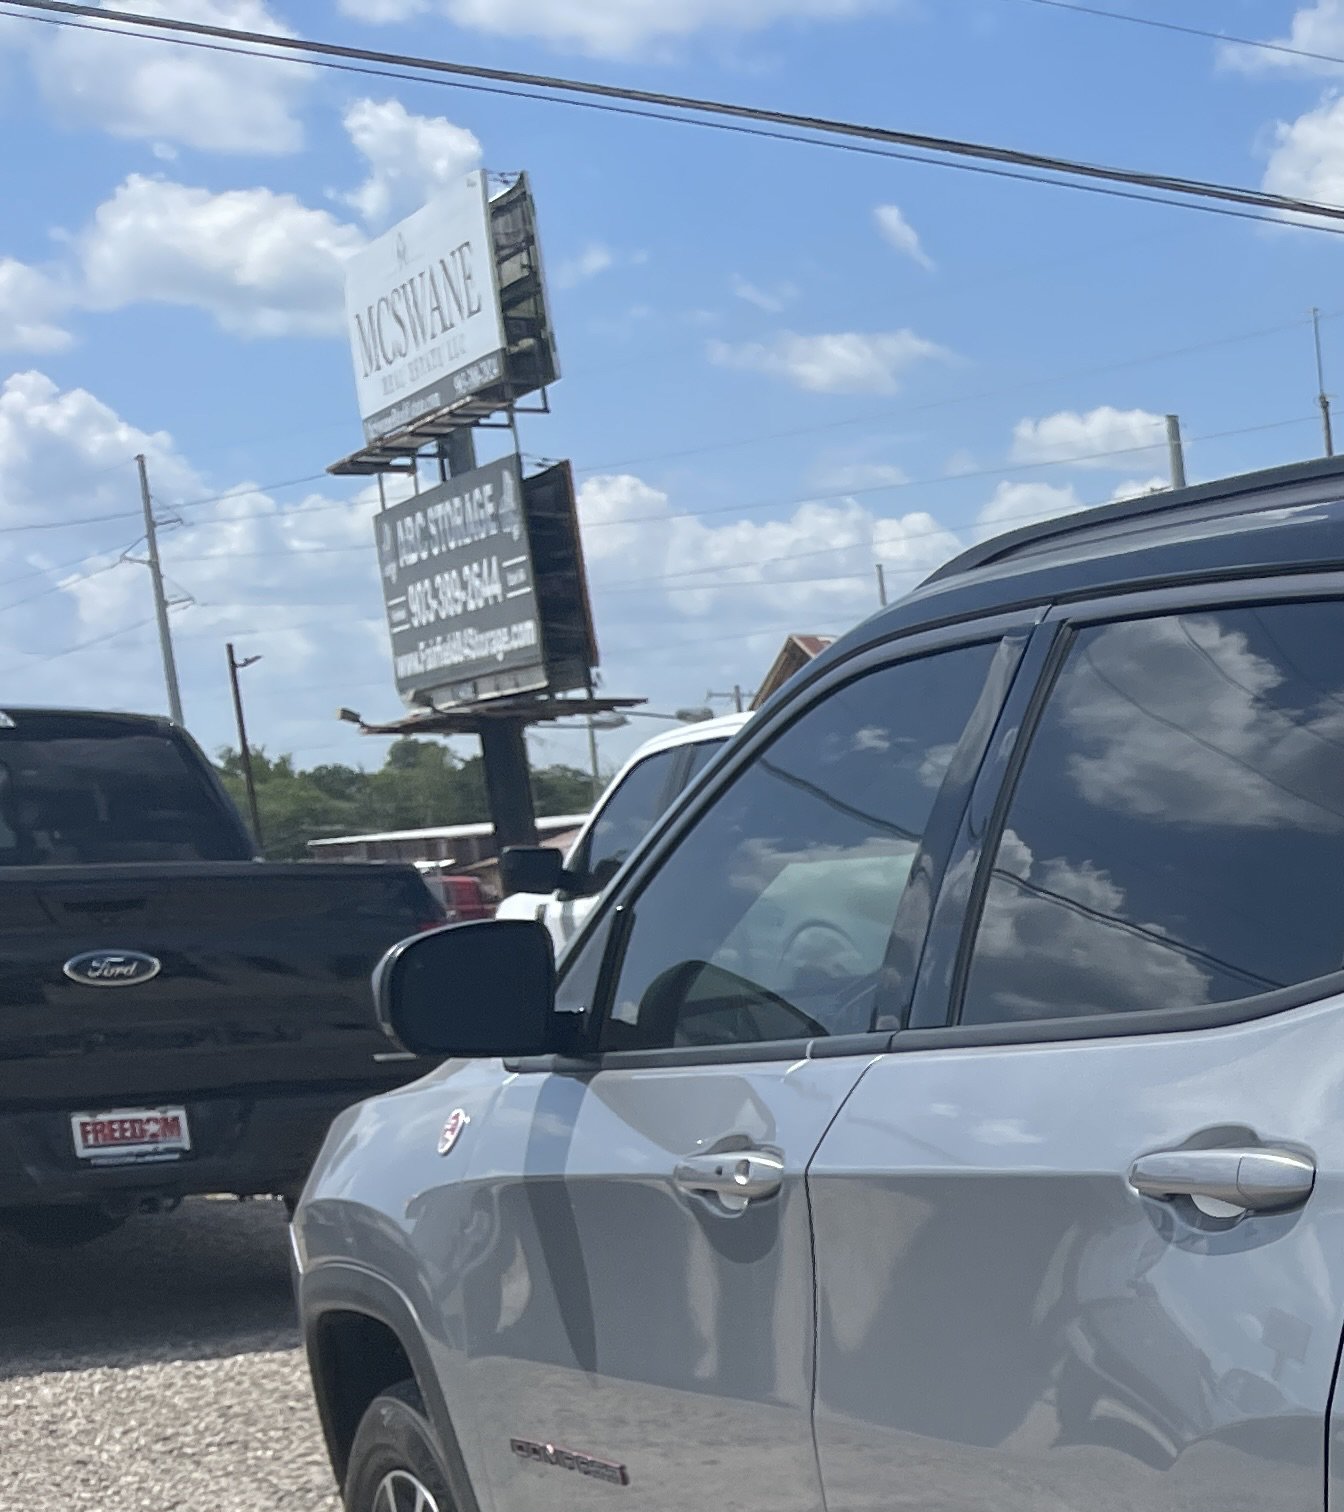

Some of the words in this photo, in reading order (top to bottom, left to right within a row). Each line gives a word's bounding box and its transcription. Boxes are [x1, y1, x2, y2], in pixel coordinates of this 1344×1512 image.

[355, 241, 482, 377] MCSWANE
[87, 956, 138, 978] Ford
[80, 1115, 182, 1145] FREEDOM
